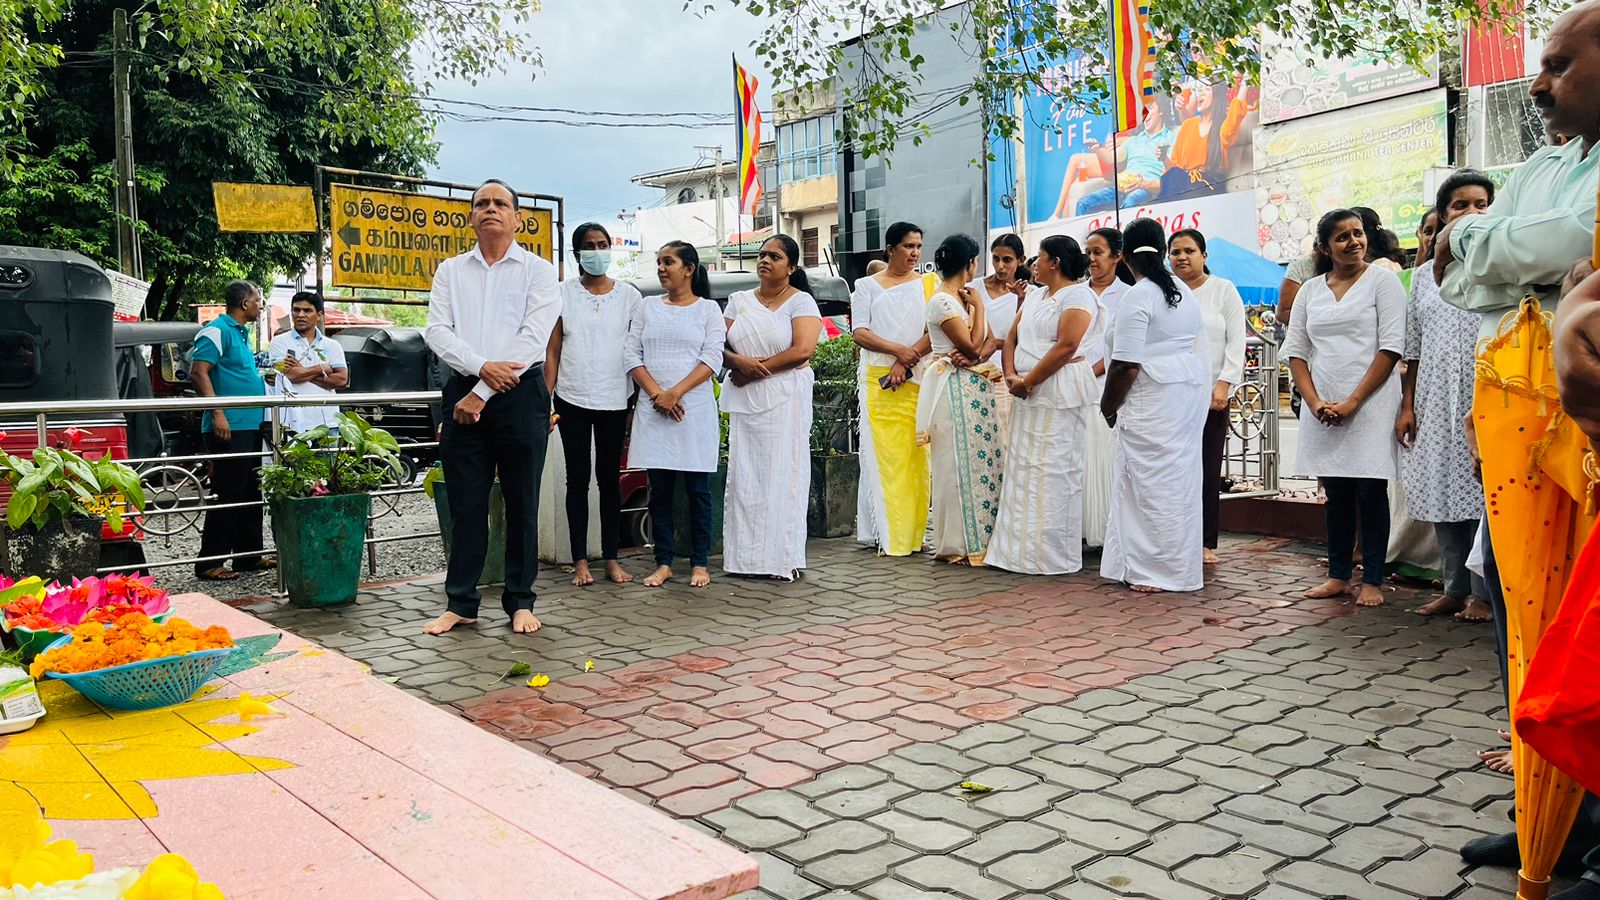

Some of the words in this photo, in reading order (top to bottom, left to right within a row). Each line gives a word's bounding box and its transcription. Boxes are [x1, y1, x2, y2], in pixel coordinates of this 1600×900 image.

[1044, 119, 1093, 153] LIFE
[1395, 136, 1433, 153] CENTER
[343, 197, 427, 228] ගම්පොල
[338, 251, 425, 278] GAMPOLA
